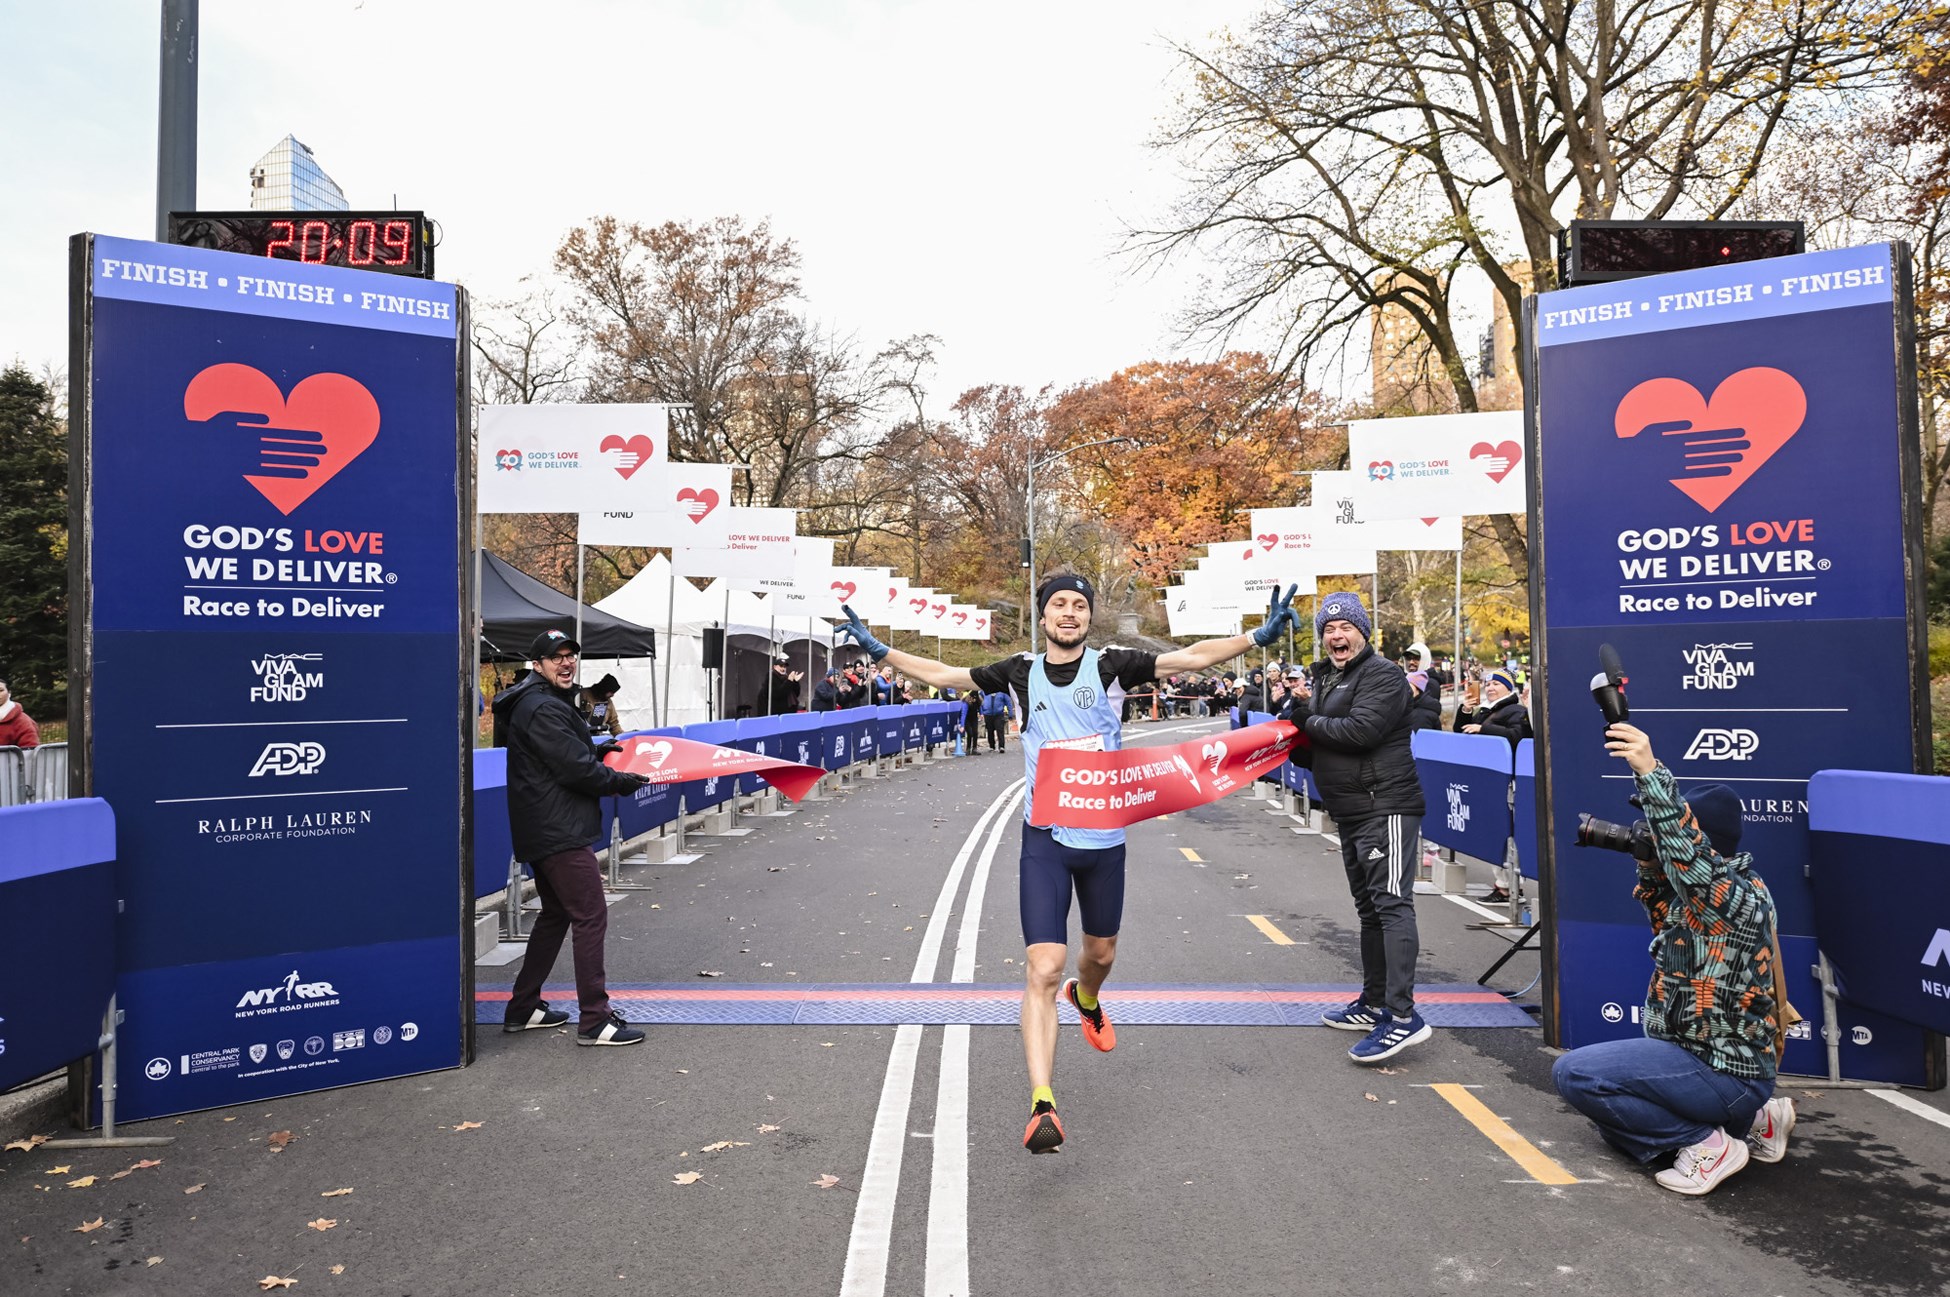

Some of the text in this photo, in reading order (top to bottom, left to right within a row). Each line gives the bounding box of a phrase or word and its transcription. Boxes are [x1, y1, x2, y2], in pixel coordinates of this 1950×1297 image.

[102, 260, 450, 320] FINISH FINISH FINISH
[1544, 265, 1885, 329] FINISH FINISH FINISH
[528, 452, 555, 460] GOD'S
[528, 461, 542, 469] WE
[1399, 460, 1449, 470] GOD'S LOVE
[1401, 470, 1414, 478] WE
[183, 524, 383, 554] GOD'S LOVE
[1283, 533, 1307, 541] GOD'S
[1617, 519, 1814, 553] GOD'S LOVE
[184, 557, 238, 580] WE
[1620, 558, 1668, 580] WE
[183, 596, 384, 618] Race to Deliver
[1619, 586, 1817, 613] Race to Deliver
[1695, 642, 1753, 650] MAC
[1682, 650, 1727, 664] VIVA
[251, 660, 297, 675] VIVA
[1695, 661, 1754, 677] GLAM
[264, 673, 323, 688] GLAM
[1682, 675, 1738, 690] FUND
[251, 687, 306, 702] FUND
[1682, 728, 1759, 761] ADP
[248, 741, 326, 777] ADP
[661, 768, 678, 776] LOVE
[1060, 759, 1177, 786] GOD'S LOVE WE DELIVER
[1058, 788, 1157, 810] Race to Deliver
[198, 810, 372, 834] RALPH LAUREN
[1447, 814, 1465, 832] FUND
[215, 827, 356, 843] CORPORATE FOUNDATION
[256, 1007, 278, 1016] YORK
[279, 1004, 302, 1012] ROAD
[303, 999, 340, 1009] RUNNERS
[1852, 1030, 1869, 1040] MTA
[191, 1047, 240, 1060] CENTRAL PARK
[191, 1054, 240, 1066] CONSERVANCY
[191, 1065, 211, 1073] central
[227, 1061, 240, 1069] park
